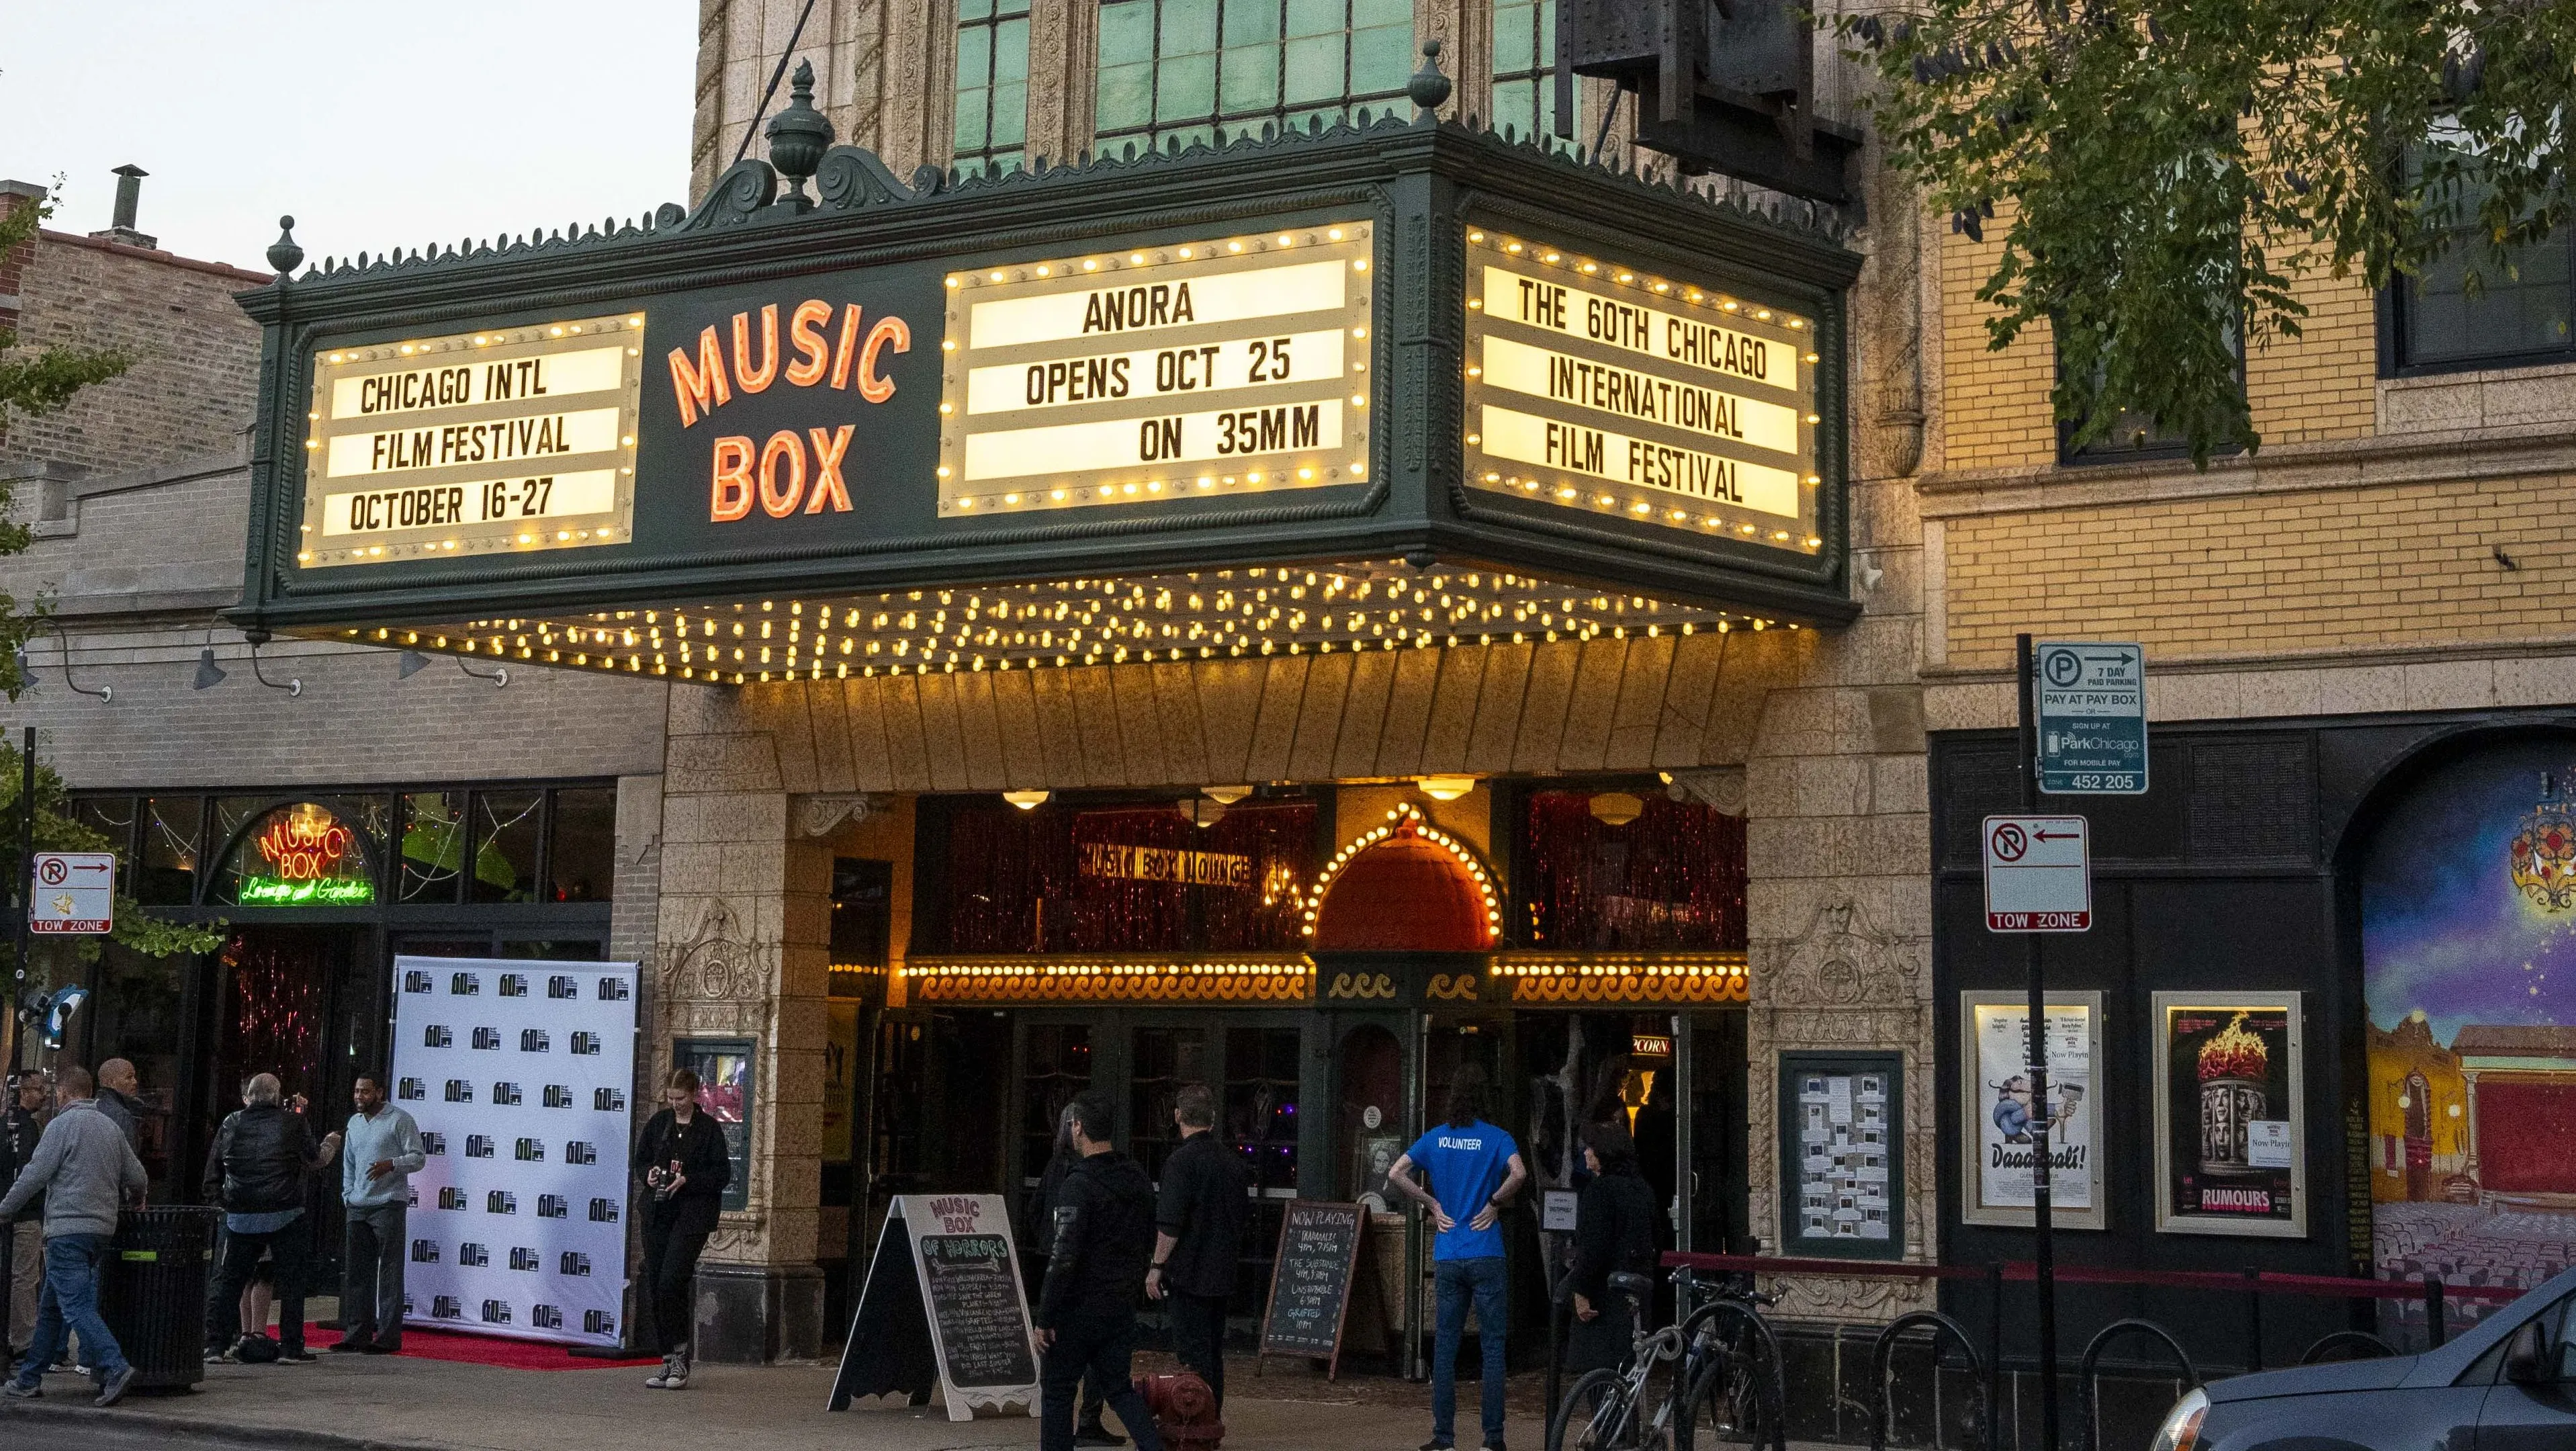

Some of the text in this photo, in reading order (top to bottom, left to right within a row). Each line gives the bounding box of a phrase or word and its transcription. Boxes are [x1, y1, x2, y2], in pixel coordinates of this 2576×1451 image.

[1082, 281, 1194, 334] ANORA
[1519, 279, 1767, 380] THE 60TH CHICAGO
[668, 300, 911, 428] MUSIC
[1026, 338, 1291, 406] OPENS OCT 25
[360, 358, 547, 414] CHICAGO INTL
[1549, 355, 1744, 439] INTERNATIONAL
[1140, 404, 1319, 462] ON 35MM
[373, 416, 570, 471] FILM FESTIVAL
[1546, 422, 1744, 504] FILM FESTIVAL
[711, 424, 856, 523] BOX
[350, 477, 553, 531] OCTOBER 16-27
[2098, 667, 2125, 677] 7 DAY
[2088, 678, 2137, 687] PAID PARKING
[2045, 695, 2137, 705] PAY AT PAY BOX
[2061, 737, 2139, 753] ParkChicago
[2072, 775, 2100, 789] 452
[2105, 775, 2134, 789] 205
[260, 817, 346, 863] MUSIC
[281, 852, 322, 879] BOX
[242, 877, 292, 902] Lounge
[316, 877, 369, 902] Garden
[37, 920, 103, 931] TOW ZONE
[1994, 913, 2082, 928] TOW ZONE
[2051, 1051, 2088, 1060] Now Playin
[1438, 1136, 1482, 1151] VOLUNTEER
[2252, 1139, 2269, 1147] Now
[2202, 1189, 2270, 1207] RUMOURS
[930, 1198, 980, 1218] MUSIC
[943, 1217, 977, 1234] BOX
[1292, 1211, 1315, 1226] NOW
[922, 1239, 1008, 1258] OF HORRORS
[1289, 1258, 1304, 1268] THE
[1287, 1308, 1321, 1320] GRAFTED
